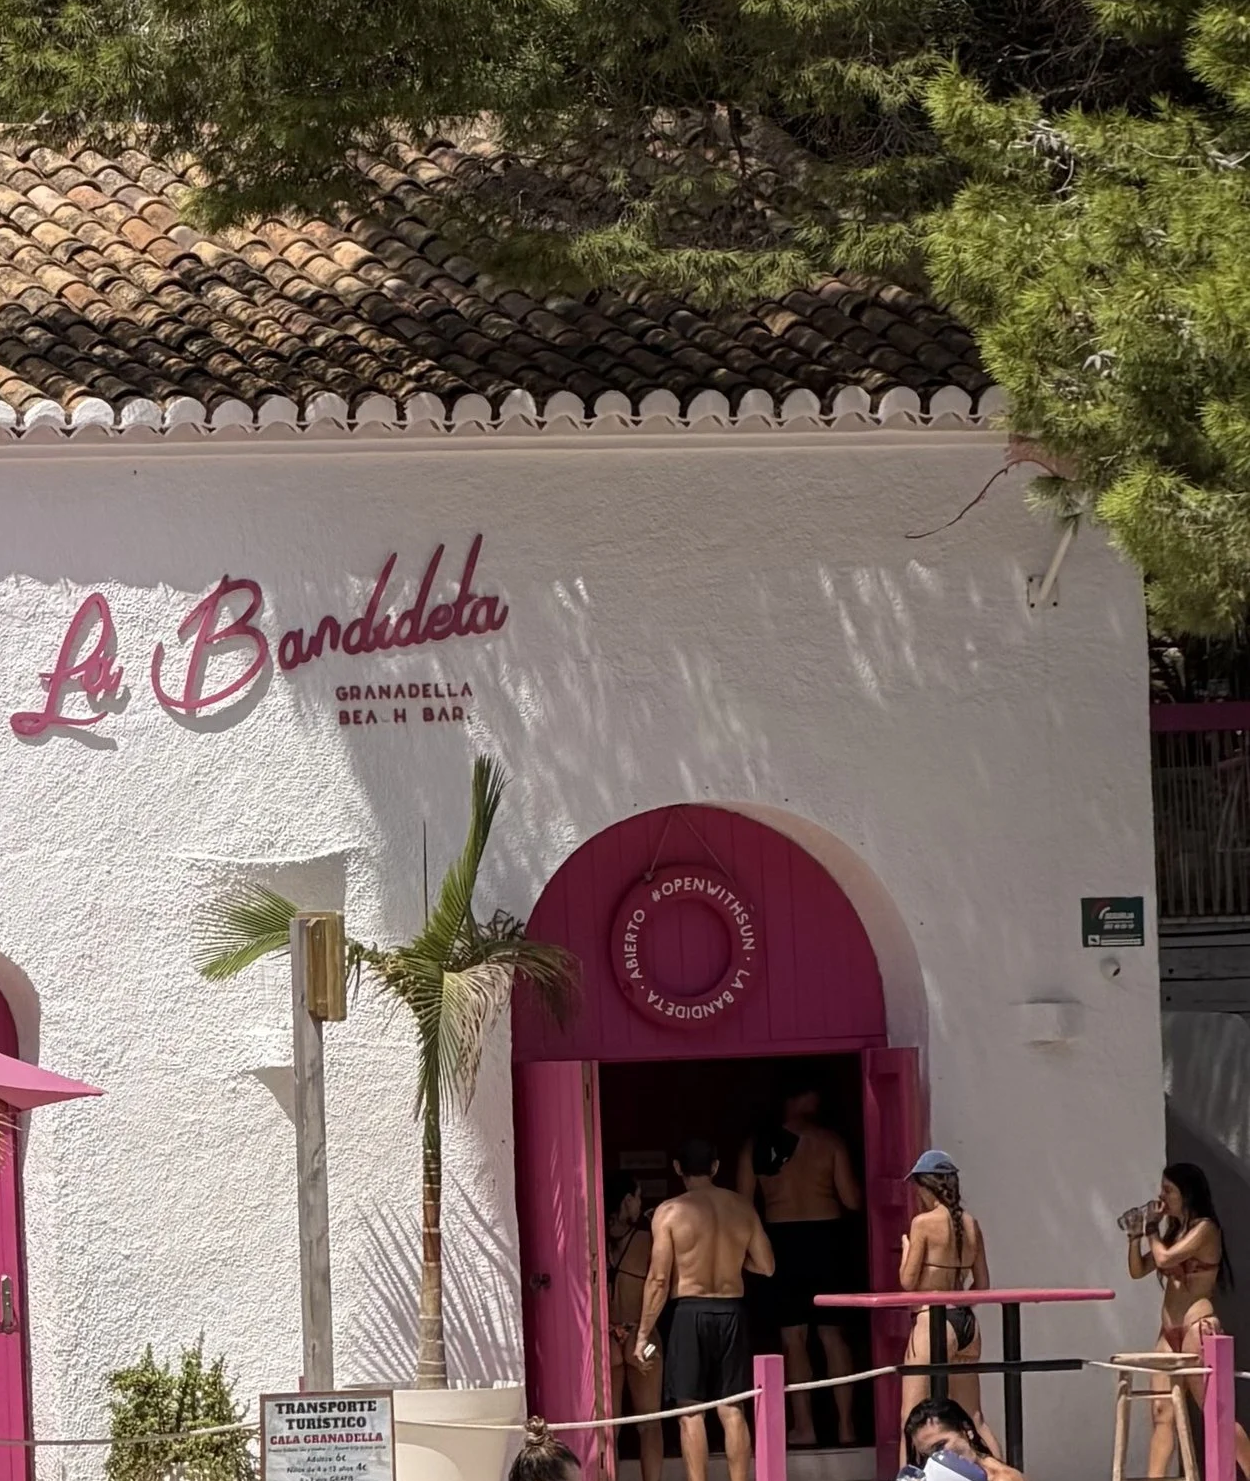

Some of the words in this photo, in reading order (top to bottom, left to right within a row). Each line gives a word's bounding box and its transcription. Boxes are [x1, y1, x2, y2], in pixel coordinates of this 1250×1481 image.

[11, 592, 123, 737] La
[152, 533, 509, 711] Bandideta
[335, 682, 473, 701] GRANADELLA
[338, 708, 407, 725] BEAH
[651, 877, 755, 950] #OPENWITHSUN
[624, 909, 645, 979] ABIERTO
[731, 969, 750, 990] LA
[647, 990, 735, 1019] BANDIDETA
[275, 1400, 377, 1414] TRANSPORTE
[286, 1415, 367, 1430] TURÍSTICO
[270, 1435, 300, 1445] CALA
[304, 1432, 383, 1444] GRANADELLA
